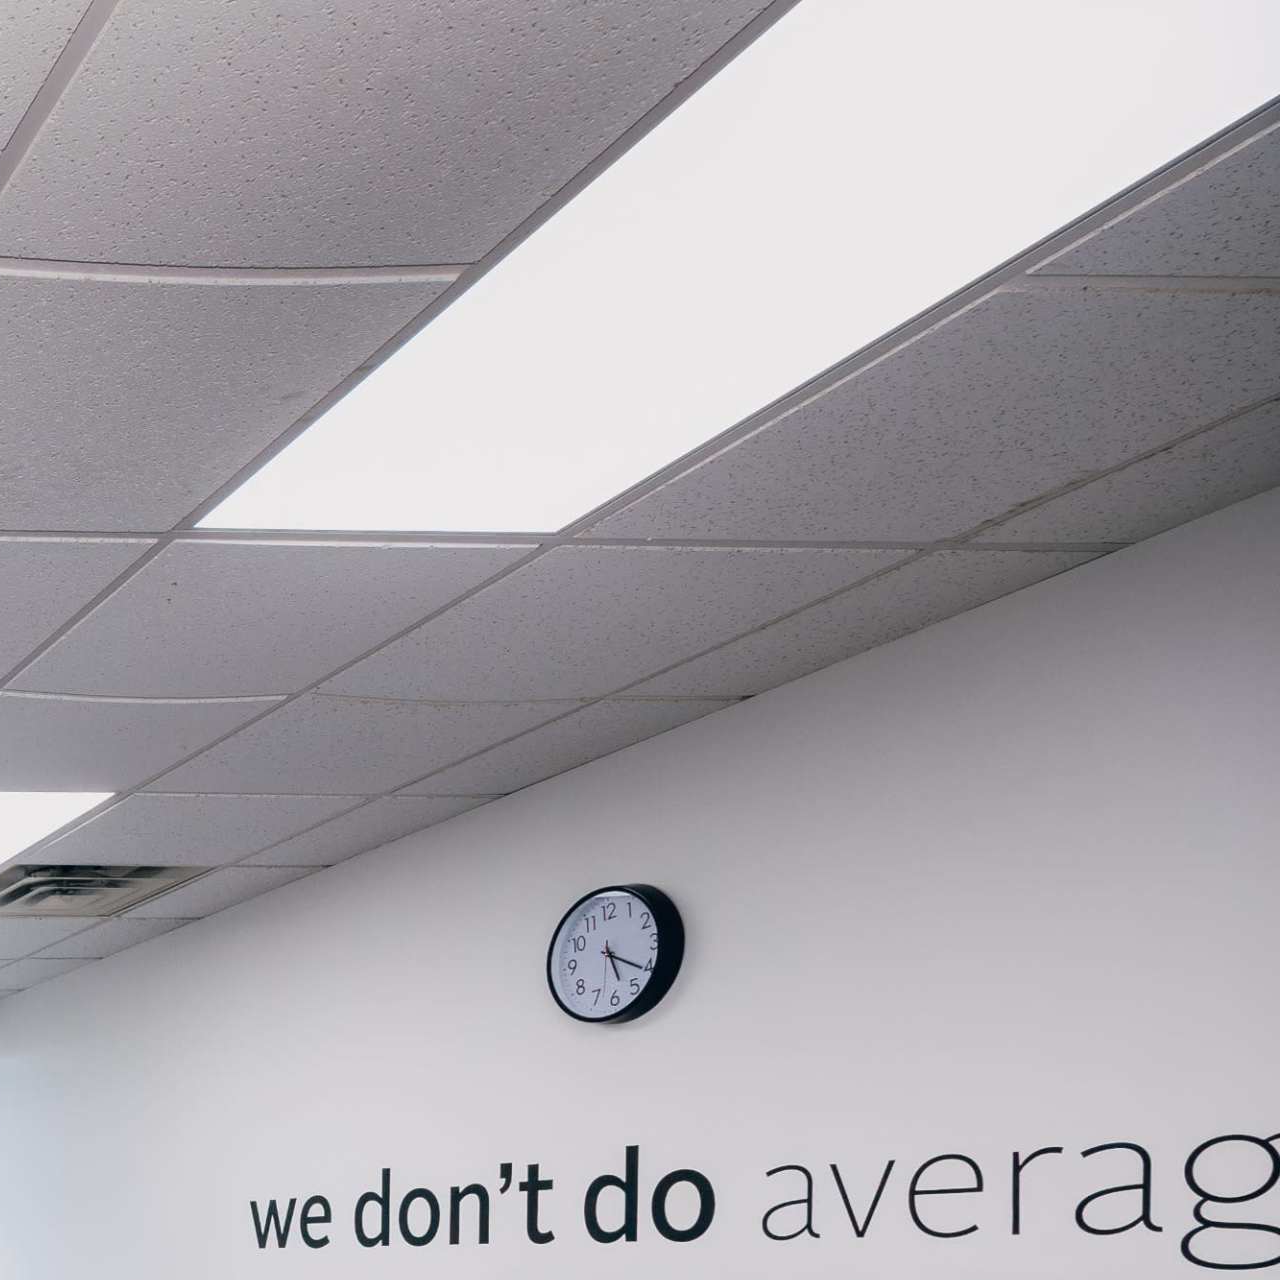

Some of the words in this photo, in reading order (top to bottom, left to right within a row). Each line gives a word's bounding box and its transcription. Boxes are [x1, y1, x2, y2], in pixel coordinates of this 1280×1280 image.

[600, 902, 617, 921] 12
[626, 902, 632, 918] 1
[584, 915, 596, 933] 11
[640, 911, 651, 929] 2
[571, 935, 585, 952] 10
[649, 932, 659, 950] 3
[567, 959, 577, 975] 9
[644, 957, 654, 973] 4
[575, 978, 585, 995] 8
[629, 977, 640, 995] 5
[591, 988, 600, 1006] 7
[609, 989, 620, 1006] 6
[249, 1196, 332, 1249] we
[354, 1162, 555, 1249] don’t
[583, 1145, 716, 1244] do
